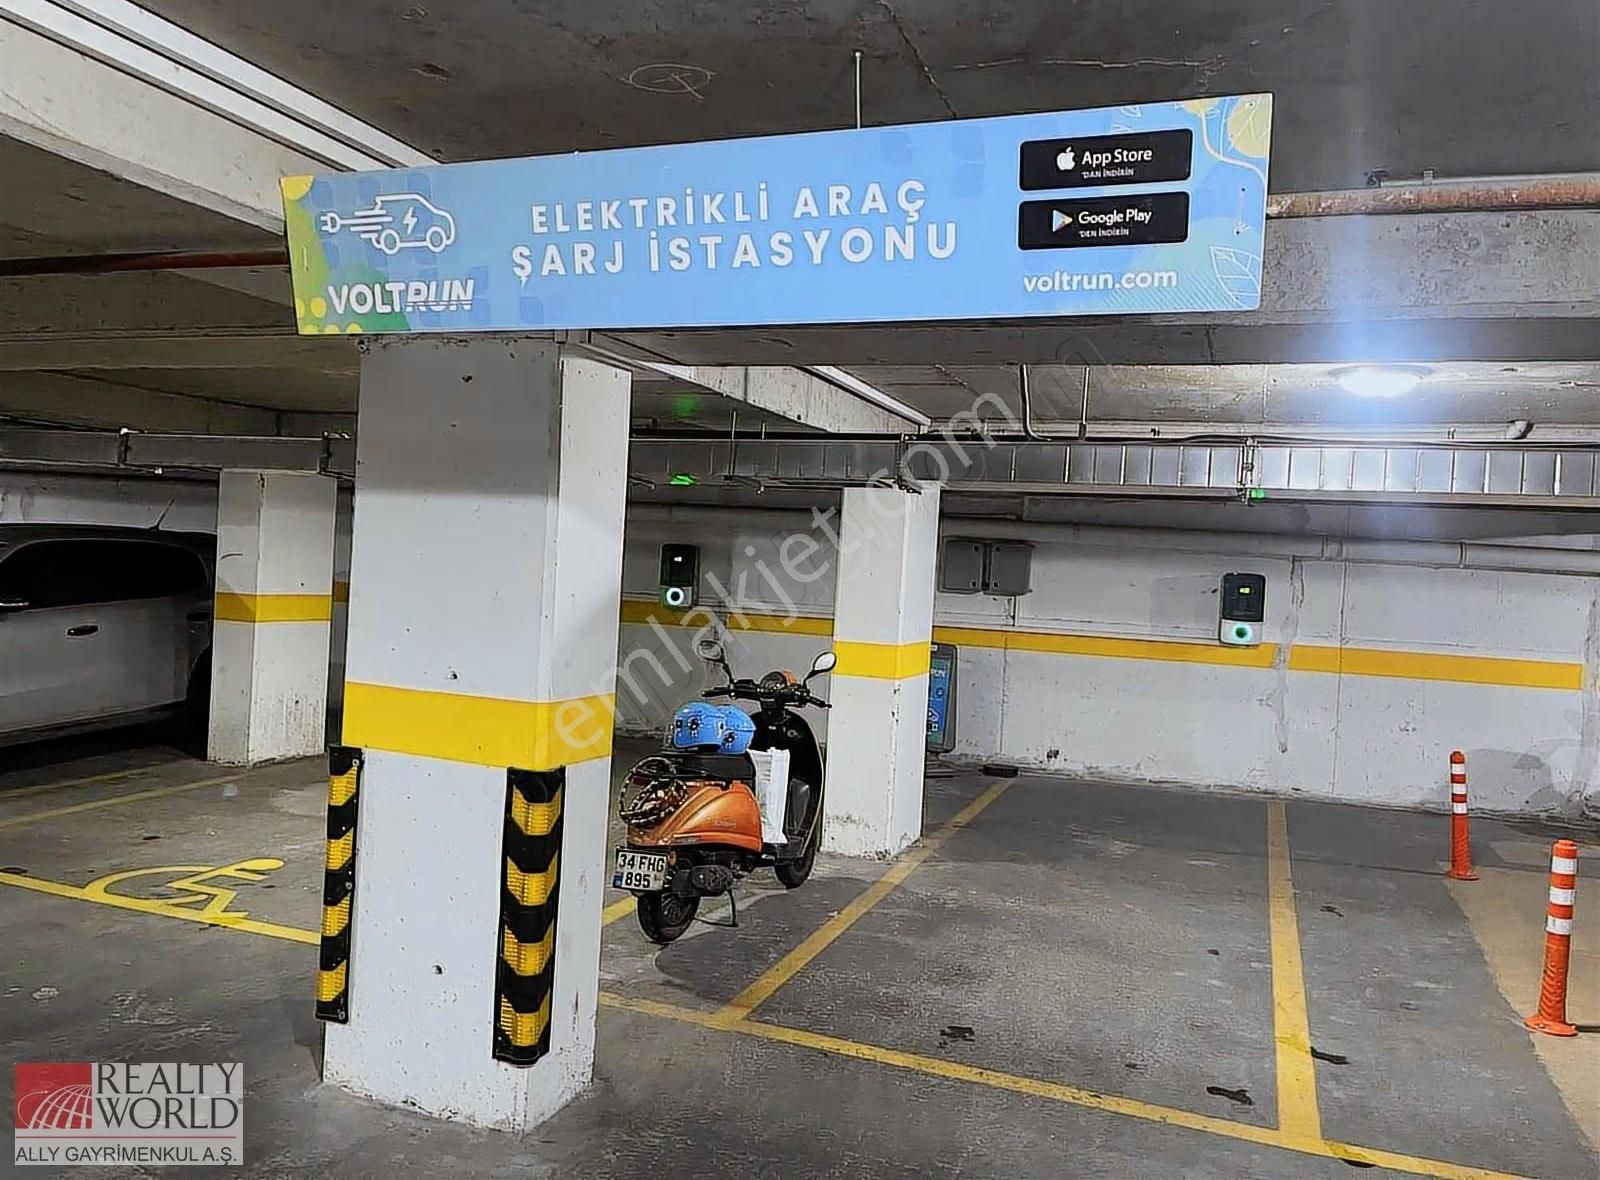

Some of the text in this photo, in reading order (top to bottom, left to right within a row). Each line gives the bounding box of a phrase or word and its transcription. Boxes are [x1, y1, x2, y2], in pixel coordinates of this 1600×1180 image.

[1081, 148, 1153, 168] App Store
[530, 179, 927, 234] ELEKTRİKLİ ARAÇ
[1078, 207, 1152, 226] Google Play
[512, 221, 958, 286] ŞARJ İSTASYONU
[1023, 269, 1178, 293] voltrun.com
[327, 278, 476, 314] VOLTRUN
[618, 853, 666, 873] 34 FHG
[624, 871, 652, 889] 895
